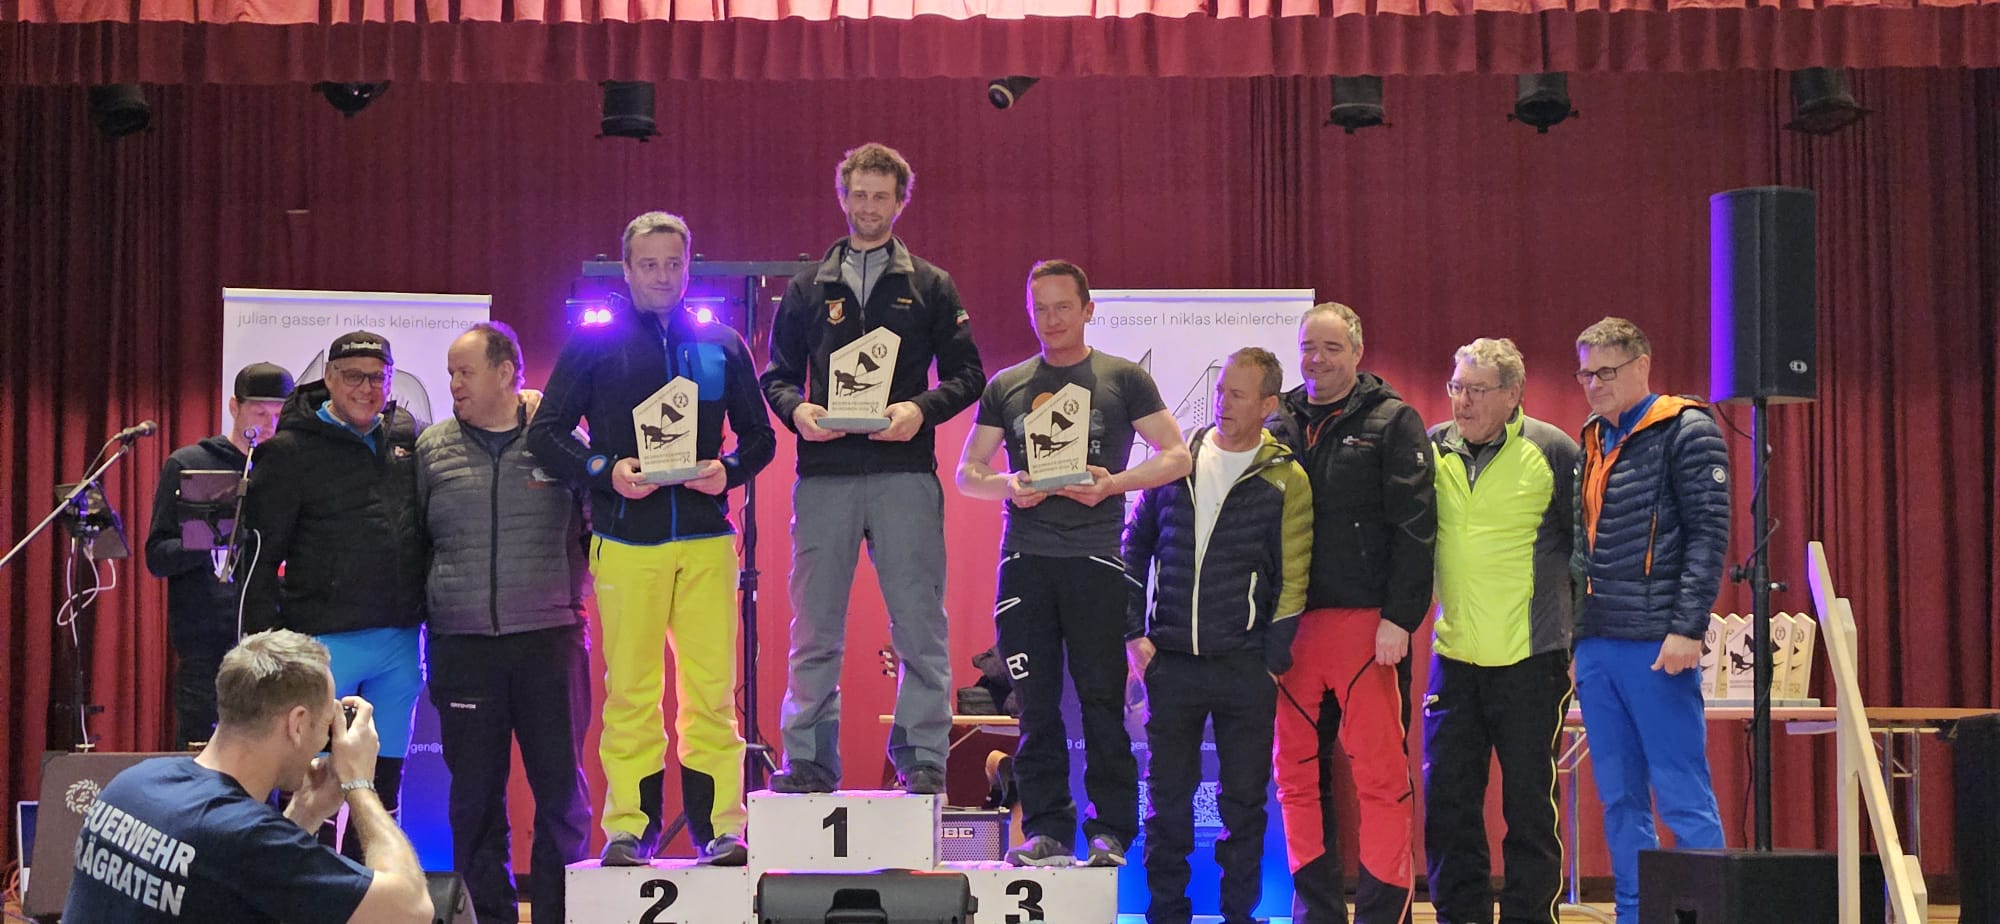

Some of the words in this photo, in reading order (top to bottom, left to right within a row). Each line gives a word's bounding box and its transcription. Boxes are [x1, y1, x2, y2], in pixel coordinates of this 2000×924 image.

[238, 313, 277, 327] julian
[282, 314, 331, 329] gasser
[343, 315, 385, 328] niklas
[390, 316, 476, 330] kleinlercher
[1110, 315, 1158, 328] gasser
[1170, 312, 1211, 326] niklas
[1215, 312, 1300, 325] kleinlercher
[822, 806, 849, 858] 1
[940, 827, 974, 838] BE
[75, 834, 186, 916] RÄGRATEN
[639, 879, 679, 924] 2
[1005, 880, 1043, 922] 3
